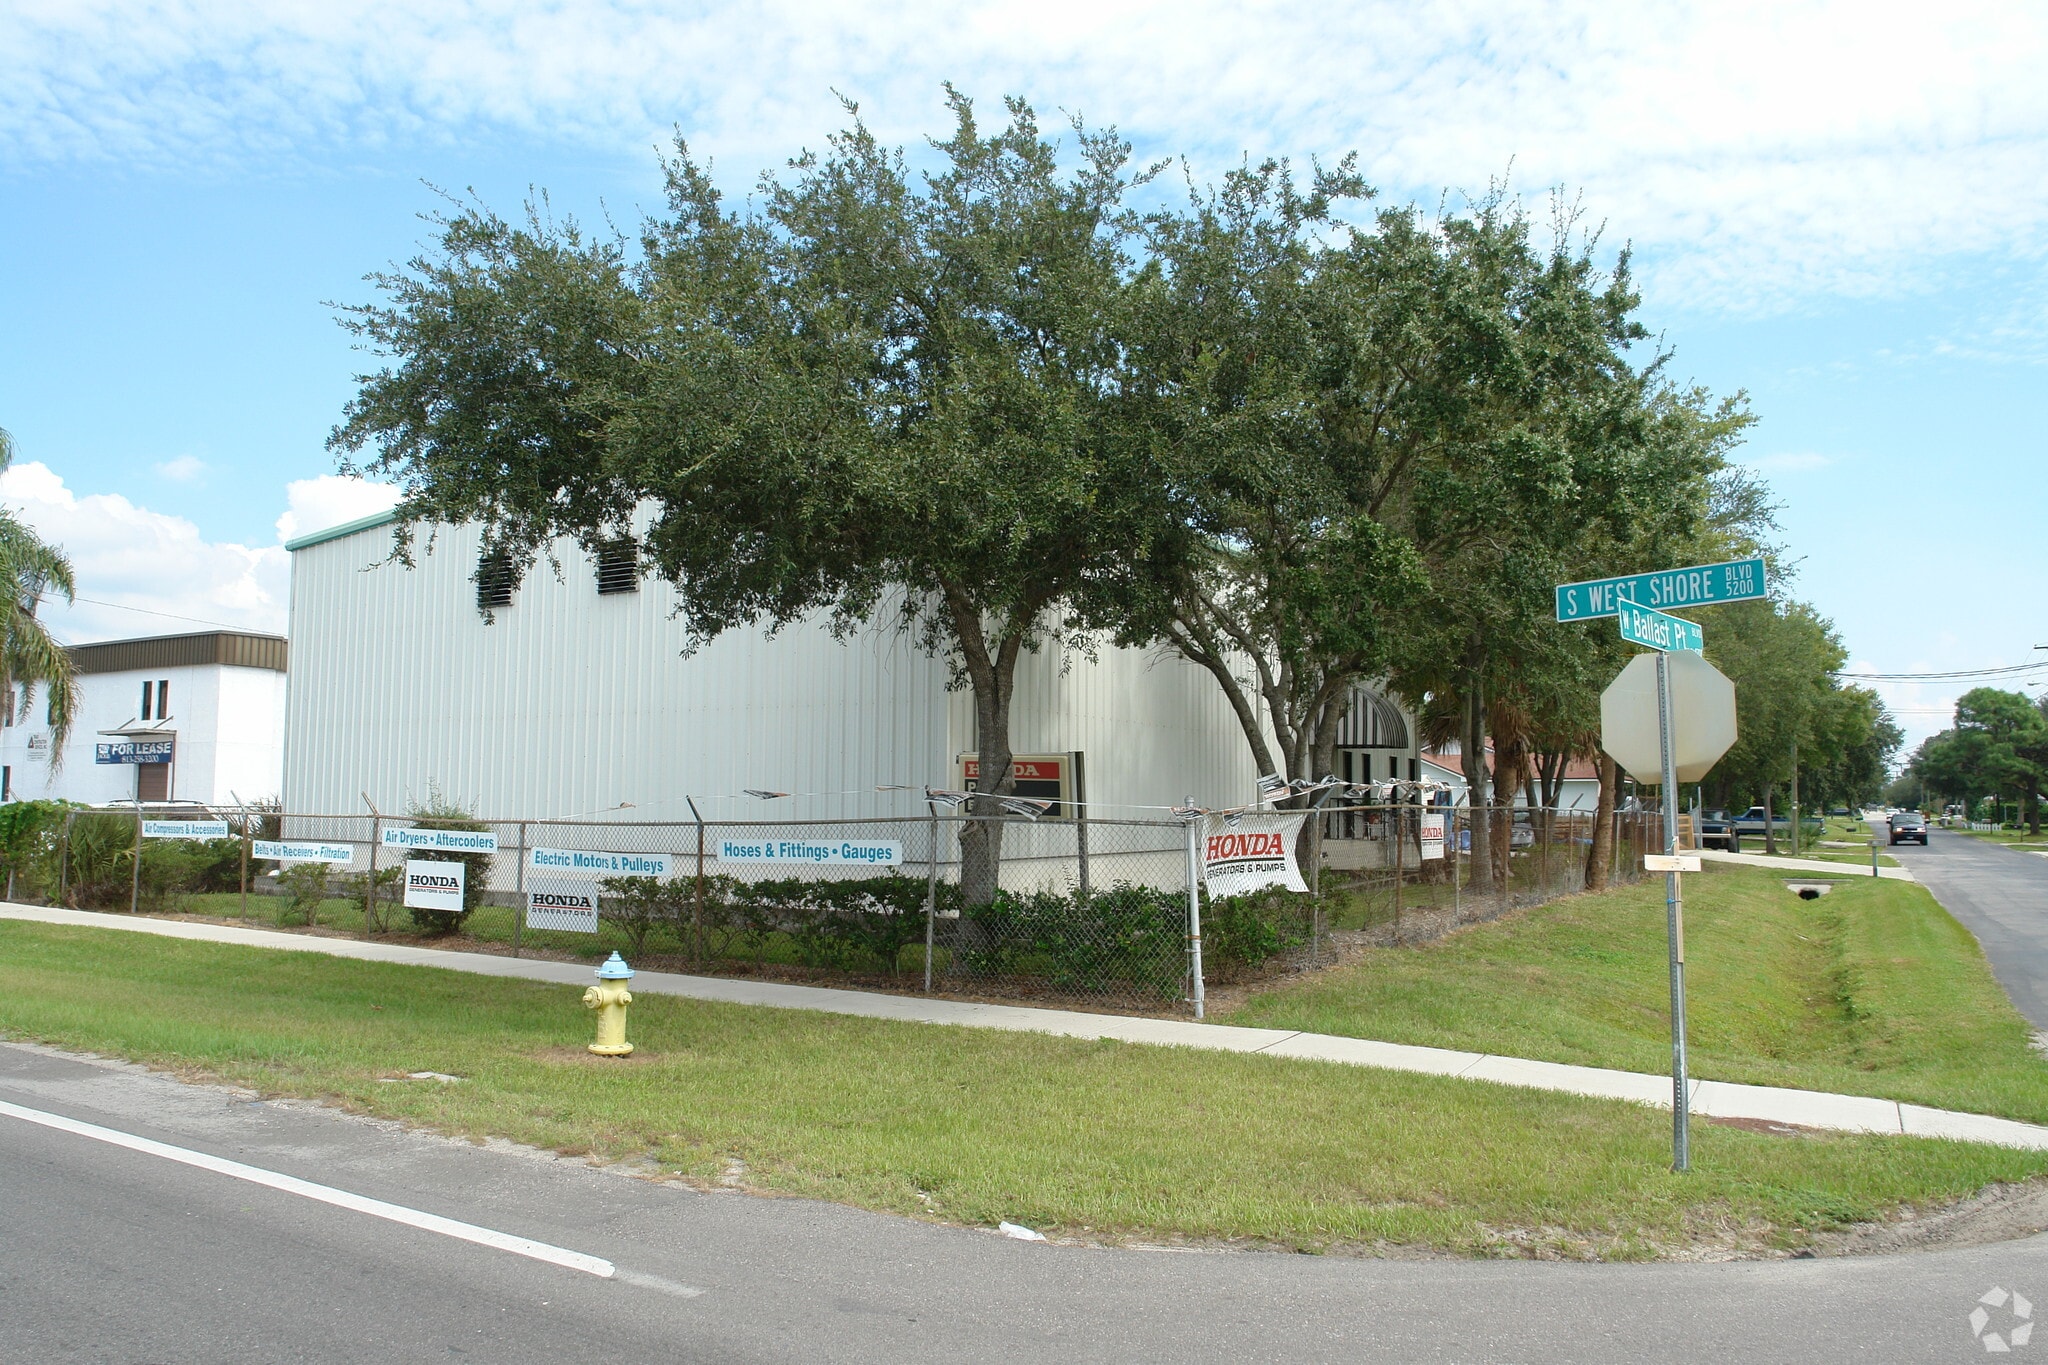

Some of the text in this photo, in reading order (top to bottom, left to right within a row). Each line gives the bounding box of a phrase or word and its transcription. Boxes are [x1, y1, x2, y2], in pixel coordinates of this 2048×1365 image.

[1725, 565, 1752, 581] BLVD
[1567, 570, 1714, 616] S WEST SHORE
[1726, 579, 1754, 597] 5200
[1622, 609, 1688, 650] W Ballast Pt
[112, 743, 133, 755] FOR
[136, 742, 171, 755] LEASE
[968, 764, 1039, 776] HDA
[153, 823, 184, 836] Compressors
[186, 824, 190, 834] &
[192, 824, 225, 835] Accessories
[385, 830, 494, 849] Air Dryers Aftercoolers
[1206, 833, 1284, 860] HONDA
[255, 843, 350, 859] Belts Air Receivers Filtration
[724, 842, 892, 863] Hoses & Fittings Gauges
[534, 851, 664, 875] Electric Motors & Pulleys
[1207, 864, 1244, 880] GENERATORS
[1256, 863, 1286, 873] PUMPS
[409, 874, 459, 887] HONDA
[532, 893, 592, 907] HONDA
